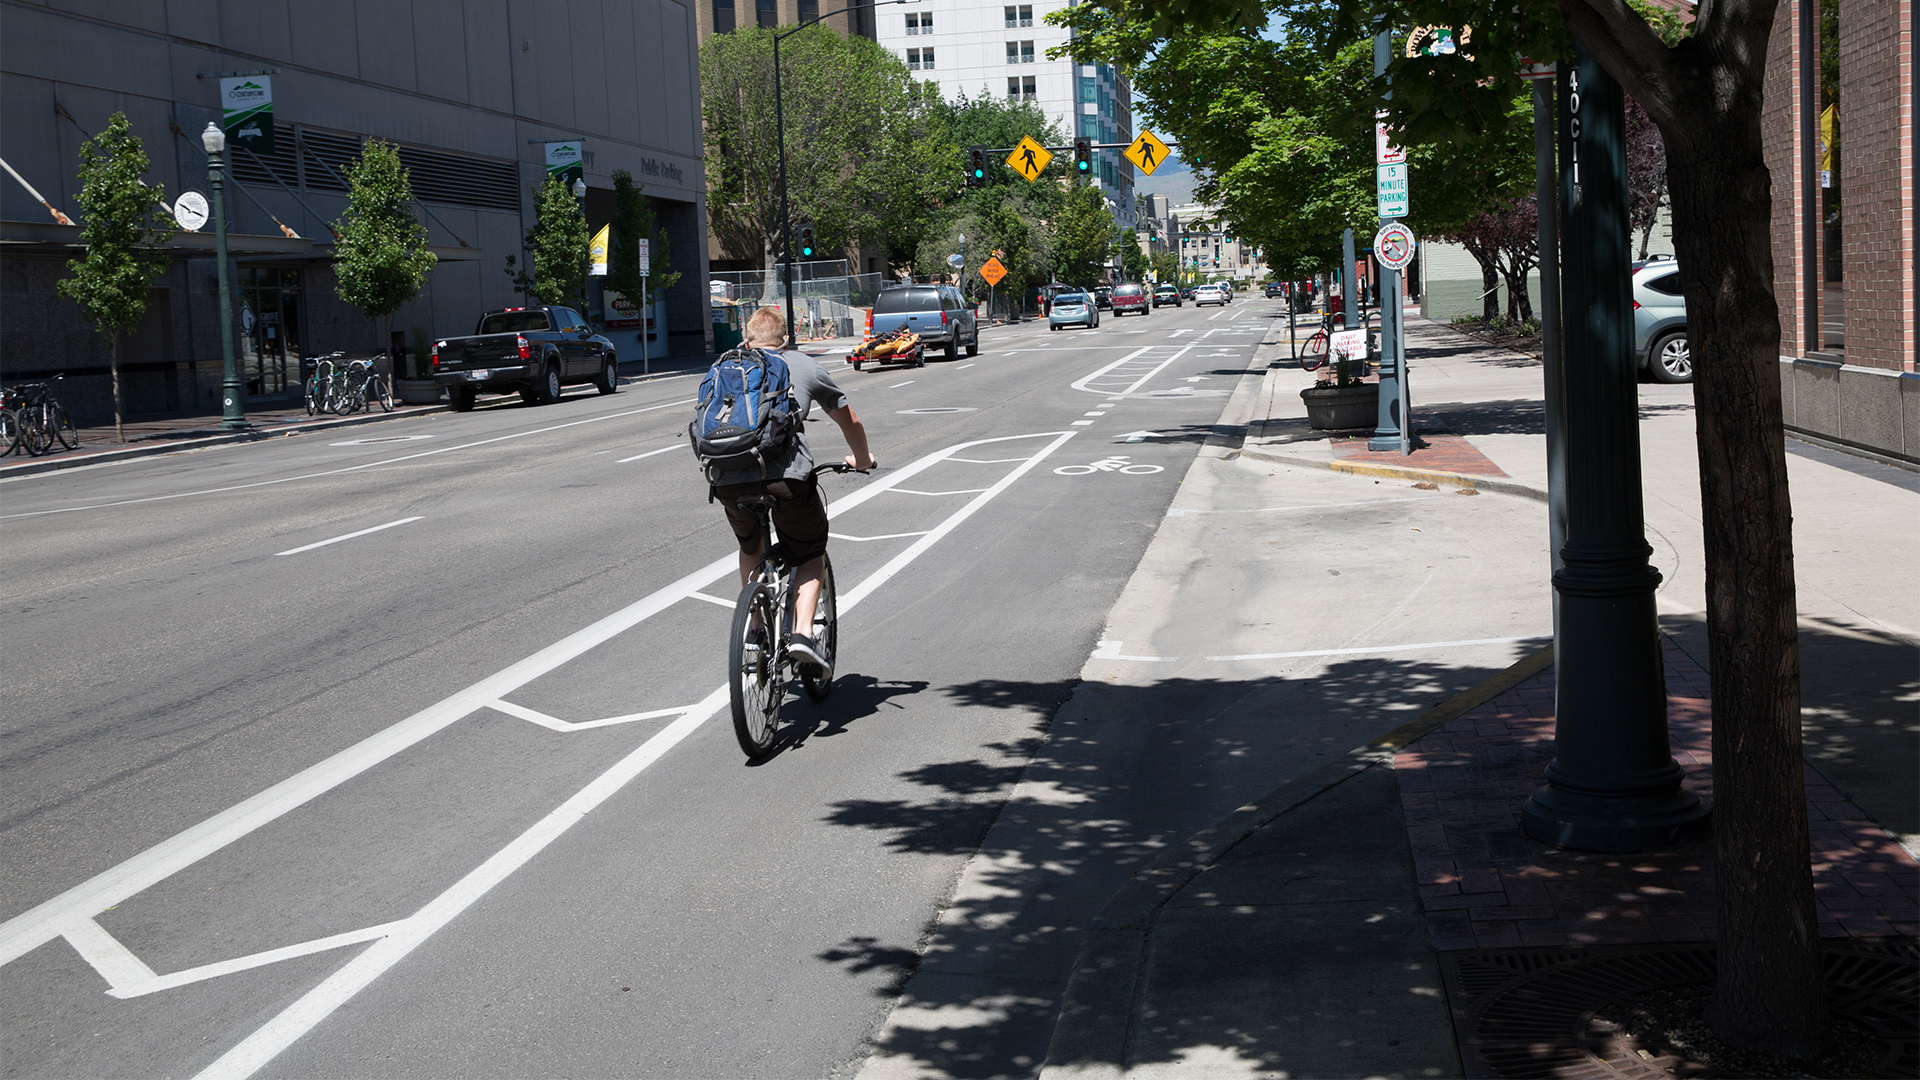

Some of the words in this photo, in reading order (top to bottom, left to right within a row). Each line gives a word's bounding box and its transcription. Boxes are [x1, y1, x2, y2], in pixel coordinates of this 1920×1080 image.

[641, 158, 660, 176] Public
[661, 162, 683, 185] Parking
[1388, 167, 1397, 178] 15
[1380, 179, 1404, 191] MINUTE
[1380, 191, 1406, 203] PARKING
[1379, 226, 1390, 236] turn
[1401, 225, 1410, 235] key
[261, 311, 279, 321] GROVE
